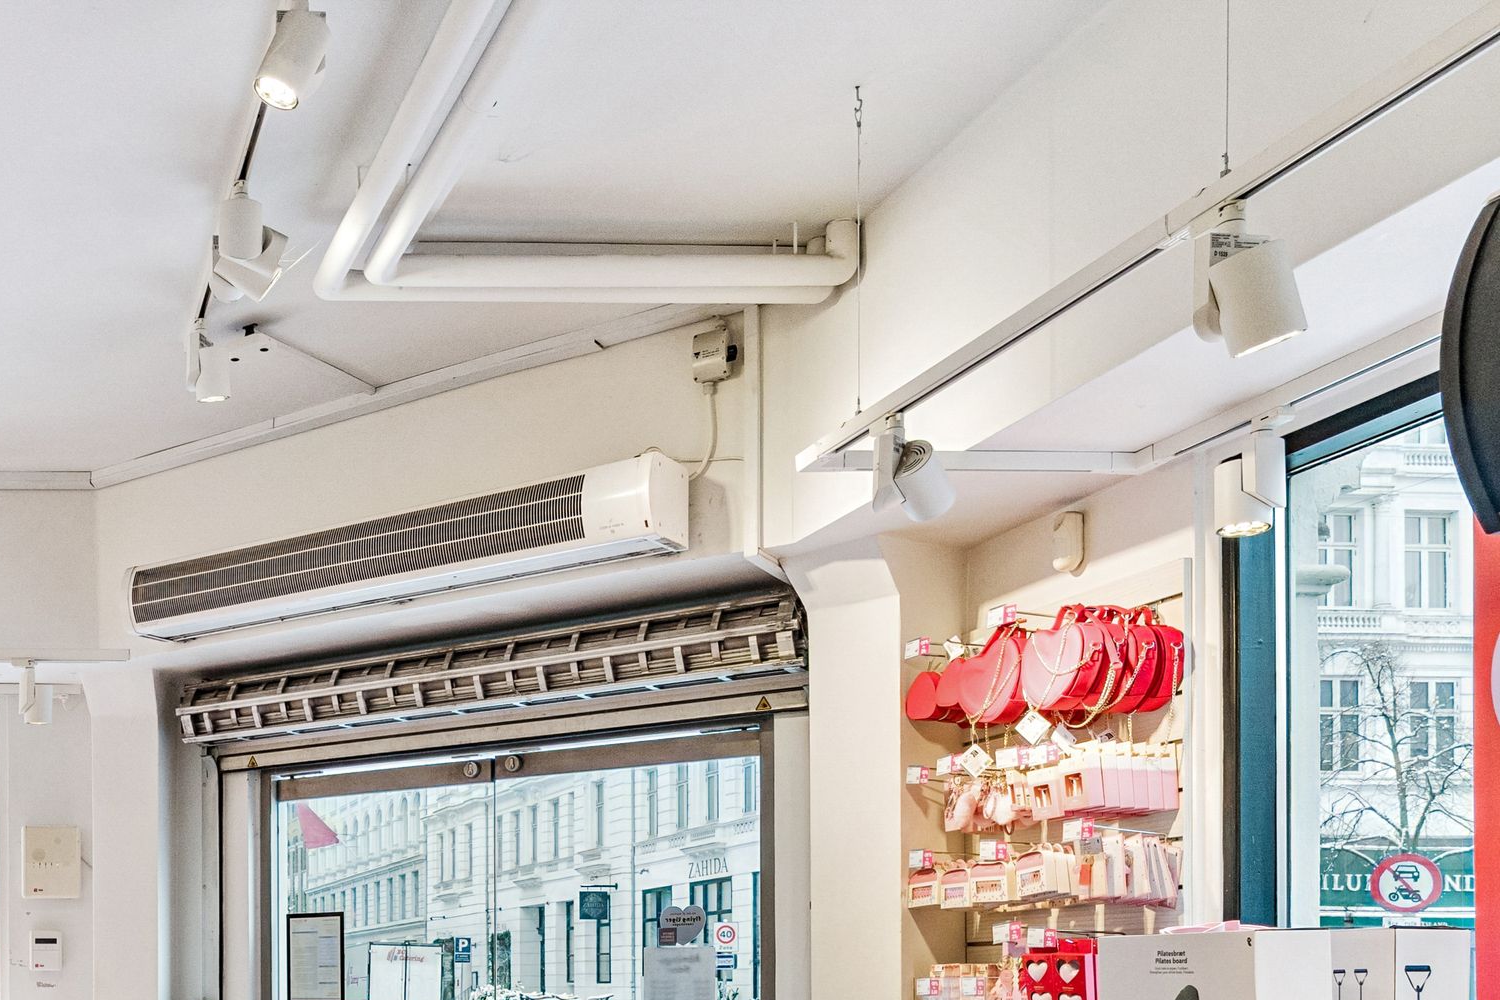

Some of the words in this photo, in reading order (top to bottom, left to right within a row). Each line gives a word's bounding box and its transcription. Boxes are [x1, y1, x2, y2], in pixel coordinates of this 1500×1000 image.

[688, 856, 729, 879] ZAHIDA
[719, 930, 732, 939] 40
[458, 938, 469, 952] P
